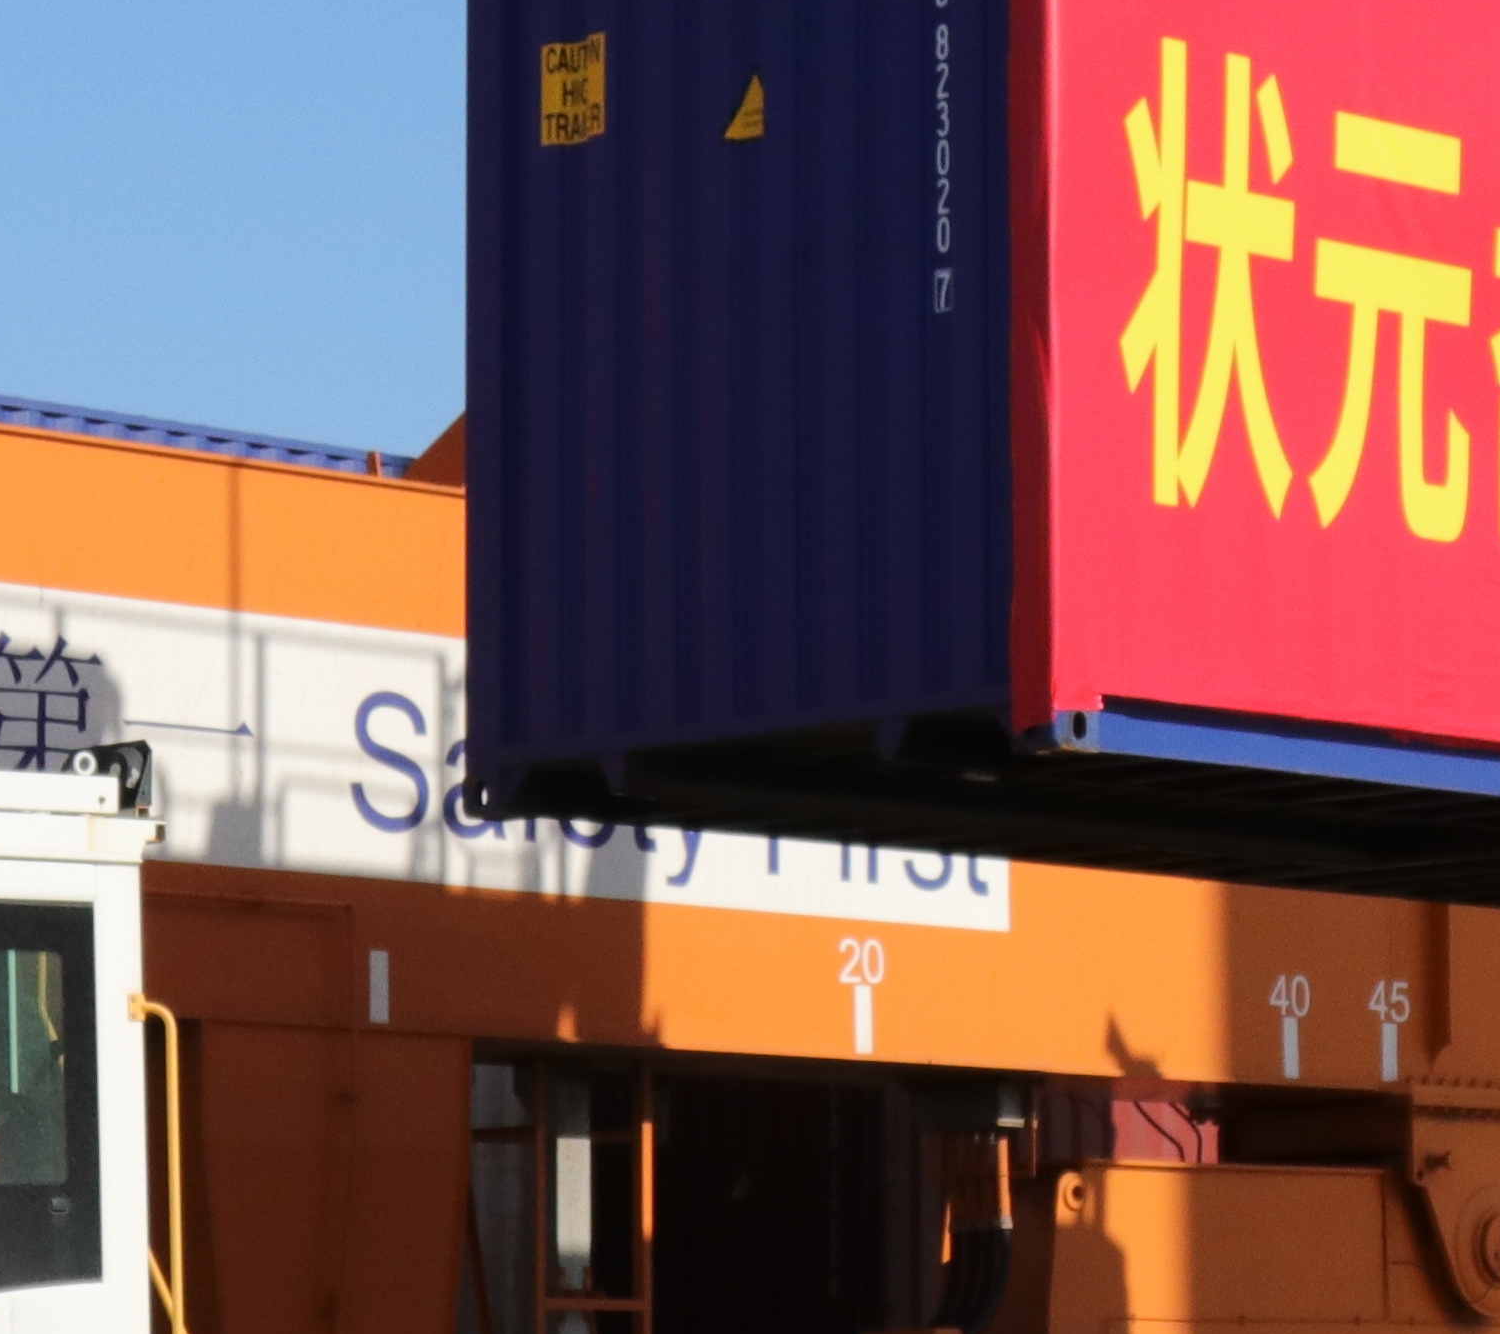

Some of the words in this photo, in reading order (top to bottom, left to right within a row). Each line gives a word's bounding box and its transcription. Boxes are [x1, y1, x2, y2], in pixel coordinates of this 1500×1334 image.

[935, 23, 950, 253] 823020
[935, 269, 952, 312] 7
[838, 938, 885, 985] 20
[1269, 974, 1311, 1018] 40
[1368, 980, 1411, 1023] 45
